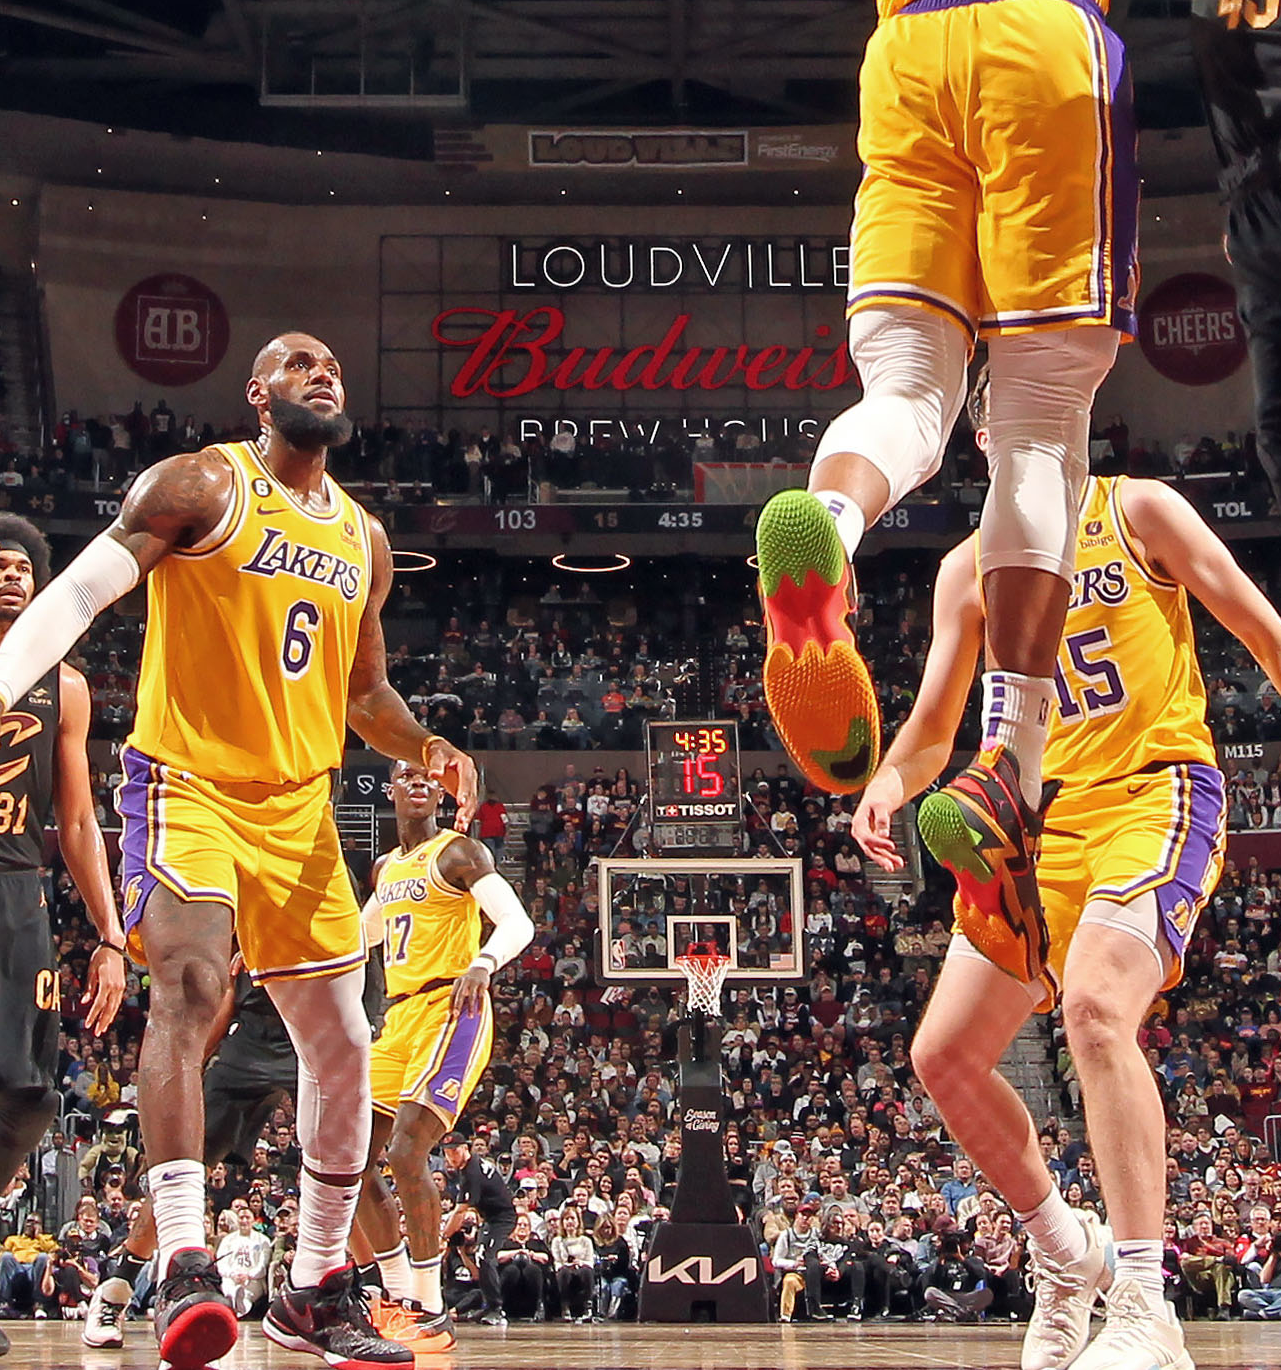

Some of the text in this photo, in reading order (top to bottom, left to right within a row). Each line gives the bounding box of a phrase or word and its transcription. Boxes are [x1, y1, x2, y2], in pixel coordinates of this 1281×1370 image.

[512, 244, 850, 288] LOUDVILLE
[144, 307, 201, 350] AB
[1153, 311, 1235, 346] CHEERS
[256, 481, 269, 496] 6
[29, 495, 55, 511] +5
[1213, 502, 1252, 518] TOL
[495, 510, 536, 529] 103
[594, 512, 618, 527] 15
[658, 512, 703, 527] 4:35
[882, 509, 909, 528] 98
[1080, 534, 1114, 549] bibigo
[239, 528, 360, 602] LAKERS
[282, 601, 319, 673] 6
[1055, 628, 1125, 718] 15
[28, 697, 52, 705] CLIFFS
[674, 730, 727, 753] 4:35
[1224, 744, 1263, 759] M115
[684, 755, 724, 796] 15
[678, 804, 736, 815] TISSOT
[386, 914, 411, 963] 17
[684, 1109, 716, 1123] Season
[693, 1120, 719, 1133] Giving
[648, 1255, 757, 1285] KIA
